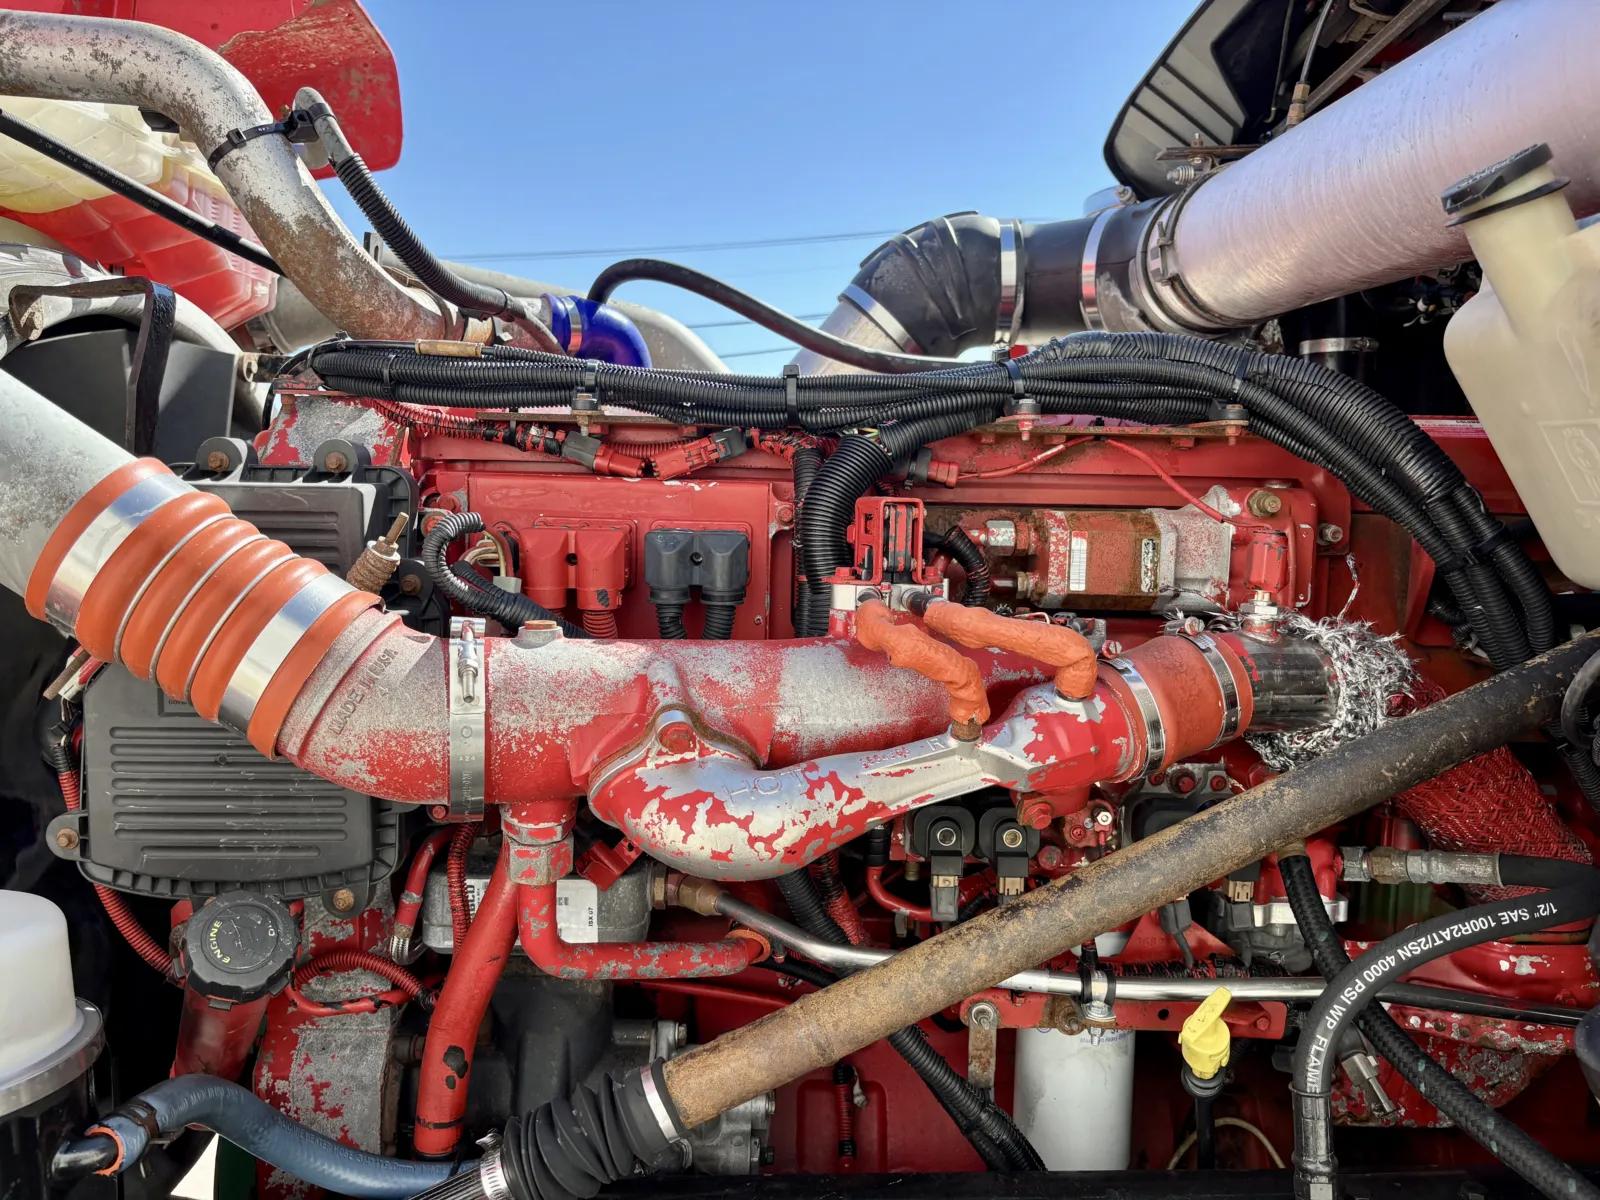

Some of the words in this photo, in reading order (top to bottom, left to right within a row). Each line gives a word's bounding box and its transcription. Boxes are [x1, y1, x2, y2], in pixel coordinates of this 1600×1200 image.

[1498, 907, 1530, 926] SAE
[1534, 902, 1558, 918] 1/2"
[209, 920, 231, 964] ENGINE
[1396, 914, 1497, 962] 100R2AT/2SN
[1363, 954, 1397, 984] 4000
[1339, 977, 1366, 1008] PSI
[1325, 1004, 1347, 1032] WP
[1305, 1034, 1328, 1094] FLAME
